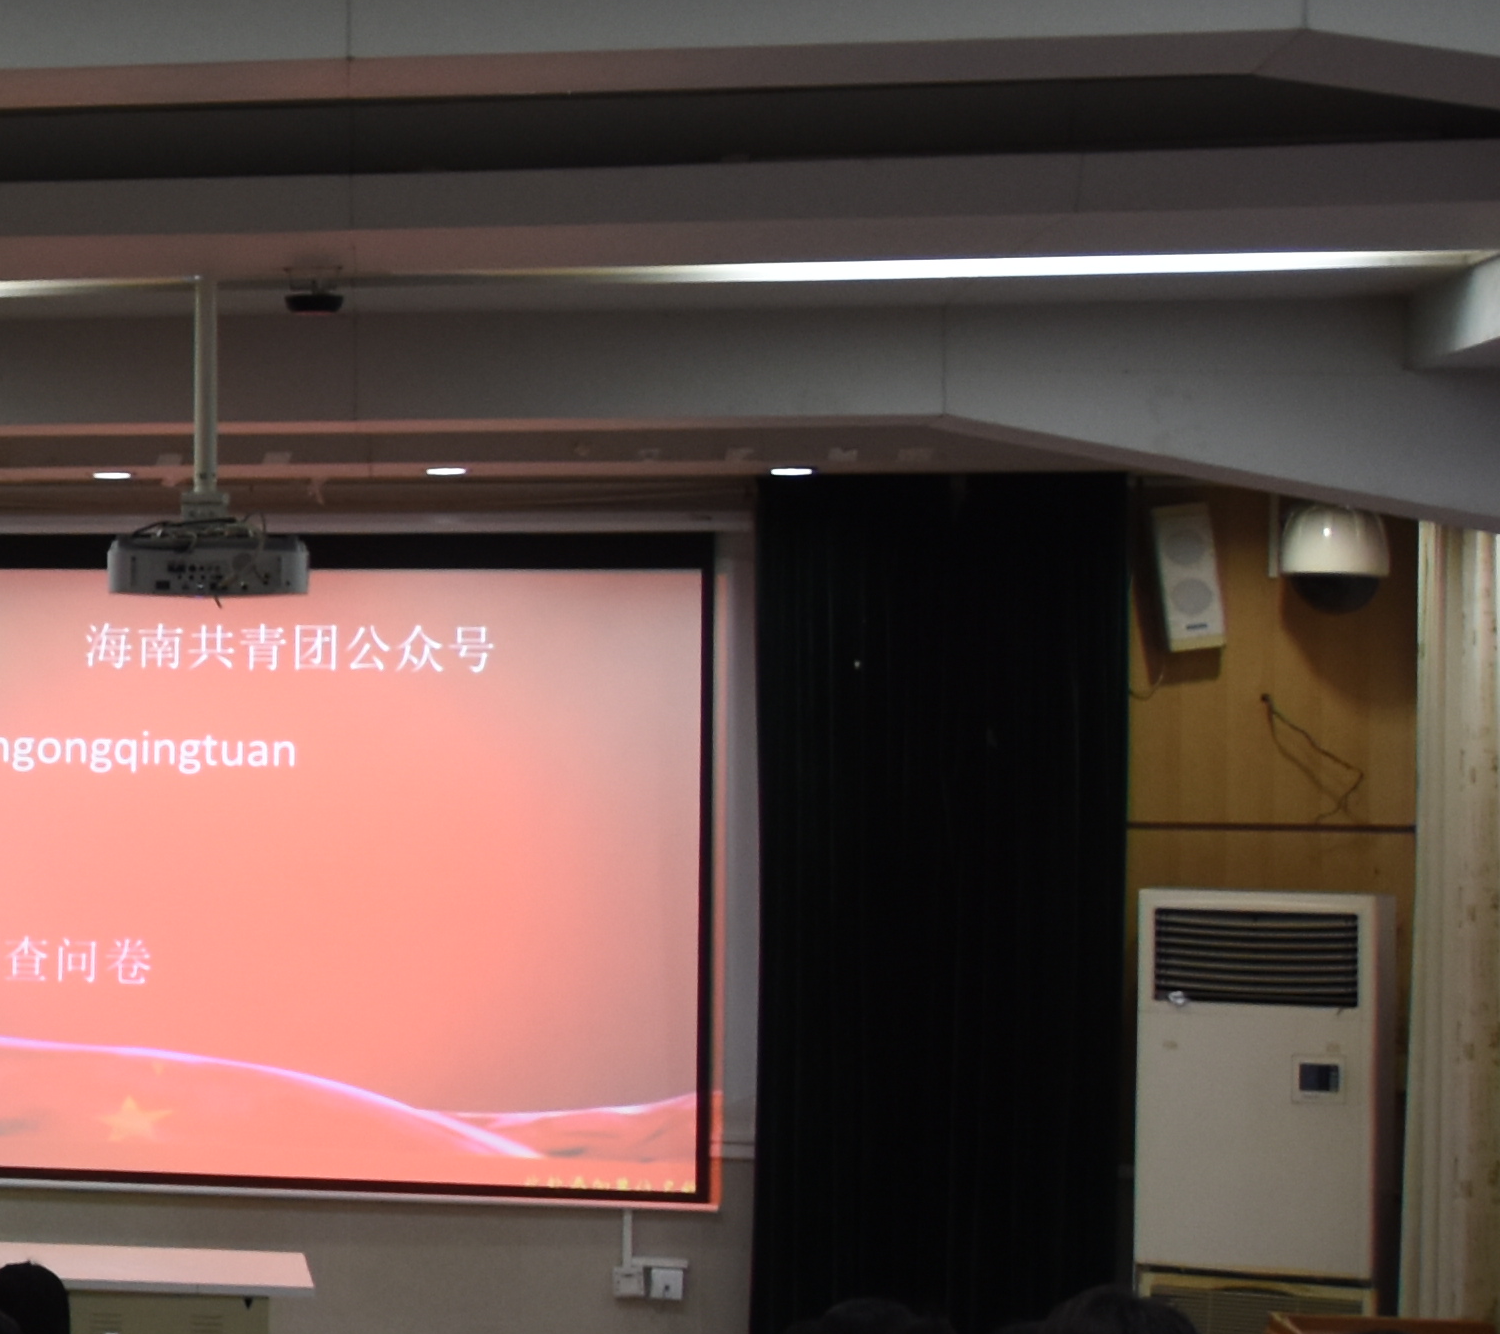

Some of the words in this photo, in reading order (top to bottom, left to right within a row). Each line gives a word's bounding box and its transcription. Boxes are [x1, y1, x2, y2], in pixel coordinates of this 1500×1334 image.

[85, 623, 495, 673] 海南共青团公众号
